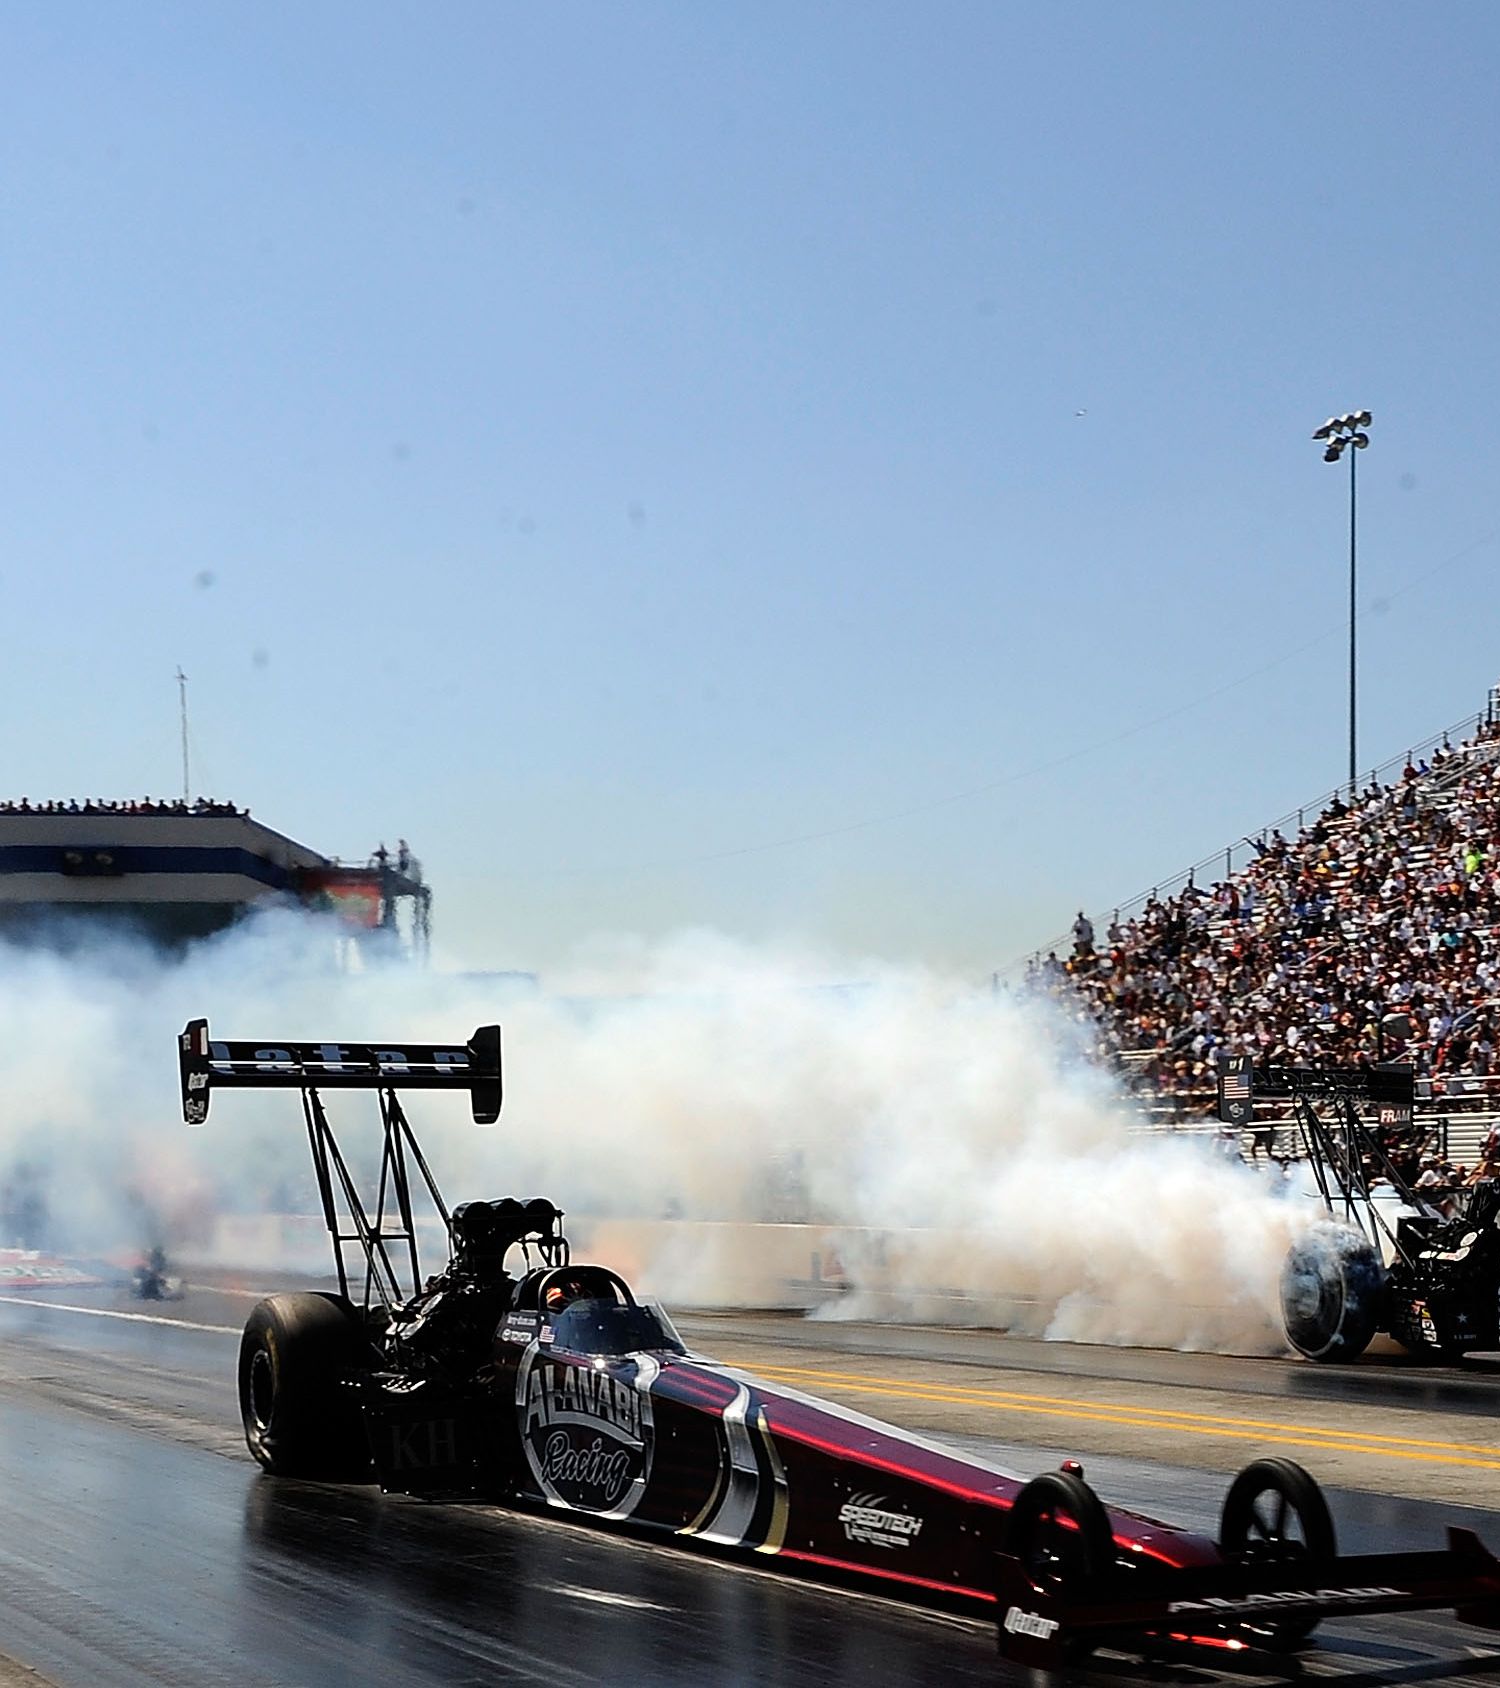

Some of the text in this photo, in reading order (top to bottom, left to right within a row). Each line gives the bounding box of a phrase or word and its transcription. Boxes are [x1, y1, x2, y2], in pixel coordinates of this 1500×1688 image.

[1380, 1109, 1411, 1123] FRAM
[541, 1430, 630, 1501] Racing
[838, 1503, 923, 1536] SPEEDTECH
